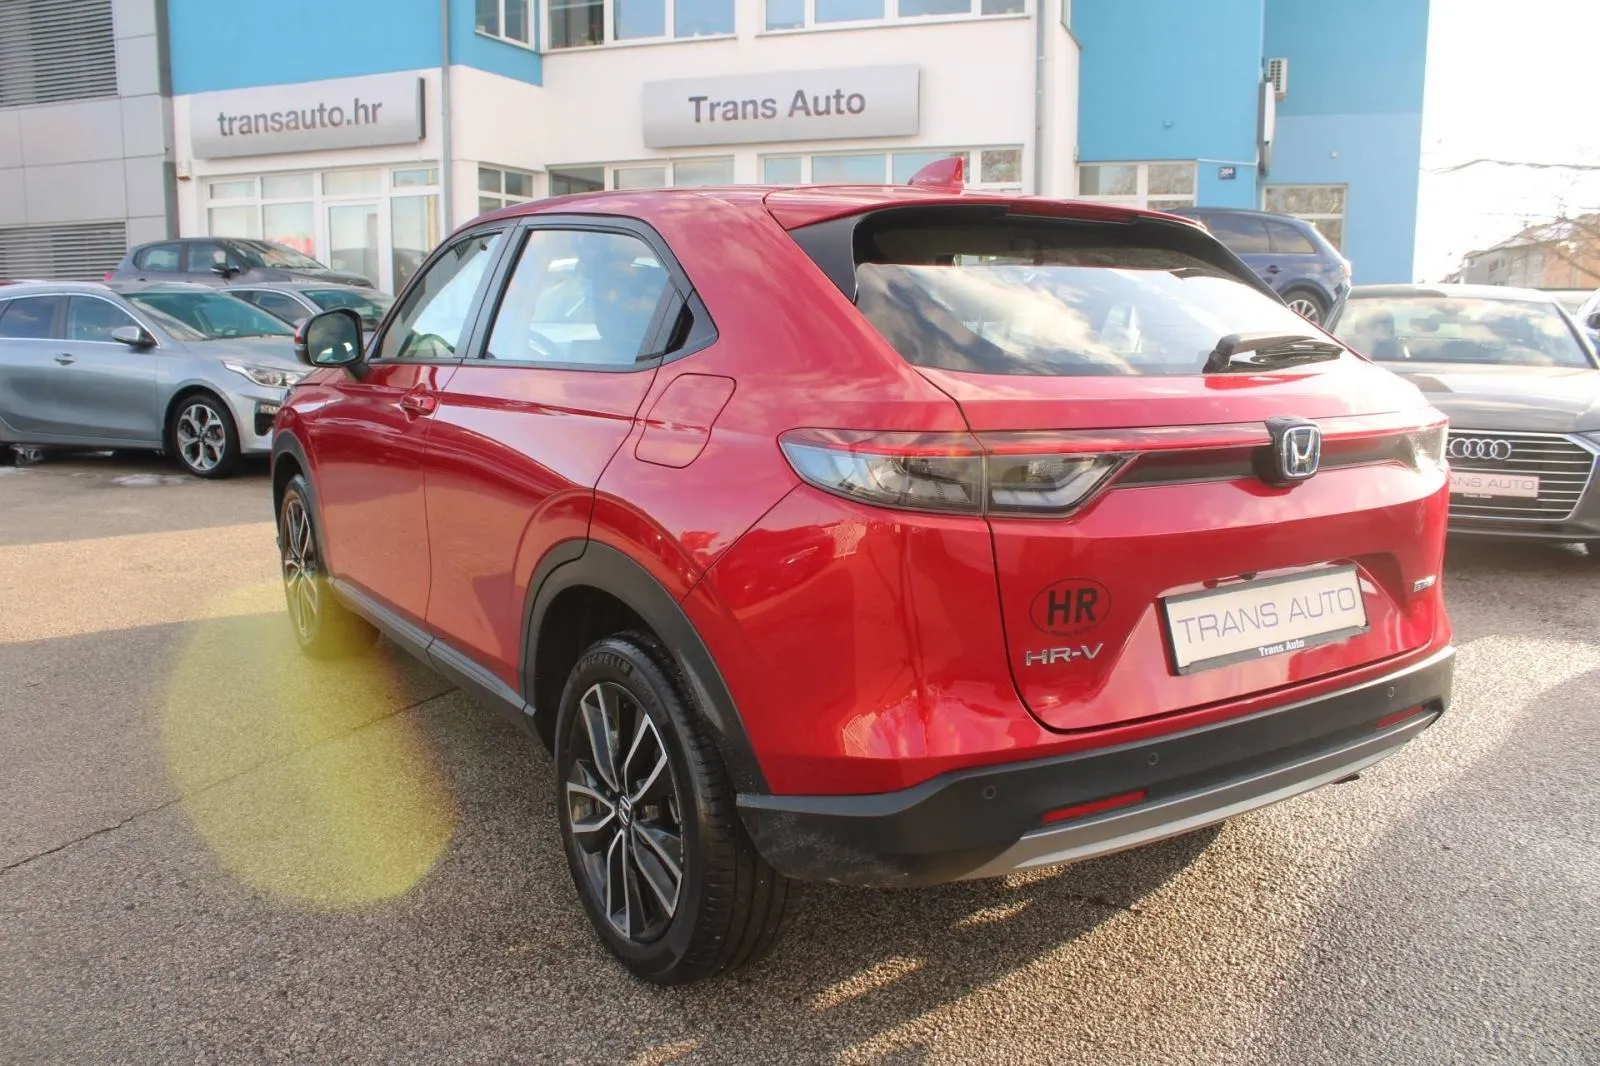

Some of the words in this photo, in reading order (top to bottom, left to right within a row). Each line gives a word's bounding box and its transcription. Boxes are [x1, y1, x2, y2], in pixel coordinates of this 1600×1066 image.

[217, 97, 383, 137] transauto.hr
[688, 96, 778, 124] Trans
[788, 88, 866, 118] Auto
[1487, 478, 1535, 490] AUTO
[1047, 587, 1099, 626] HR
[1176, 602, 1280, 644] TRANS
[1288, 587, 1357, 623] AUTO
[1026, 642, 1104, 667] HR-V
[1258, 644, 1285, 657] Trans
[1285, 639, 1305, 652] Auto
